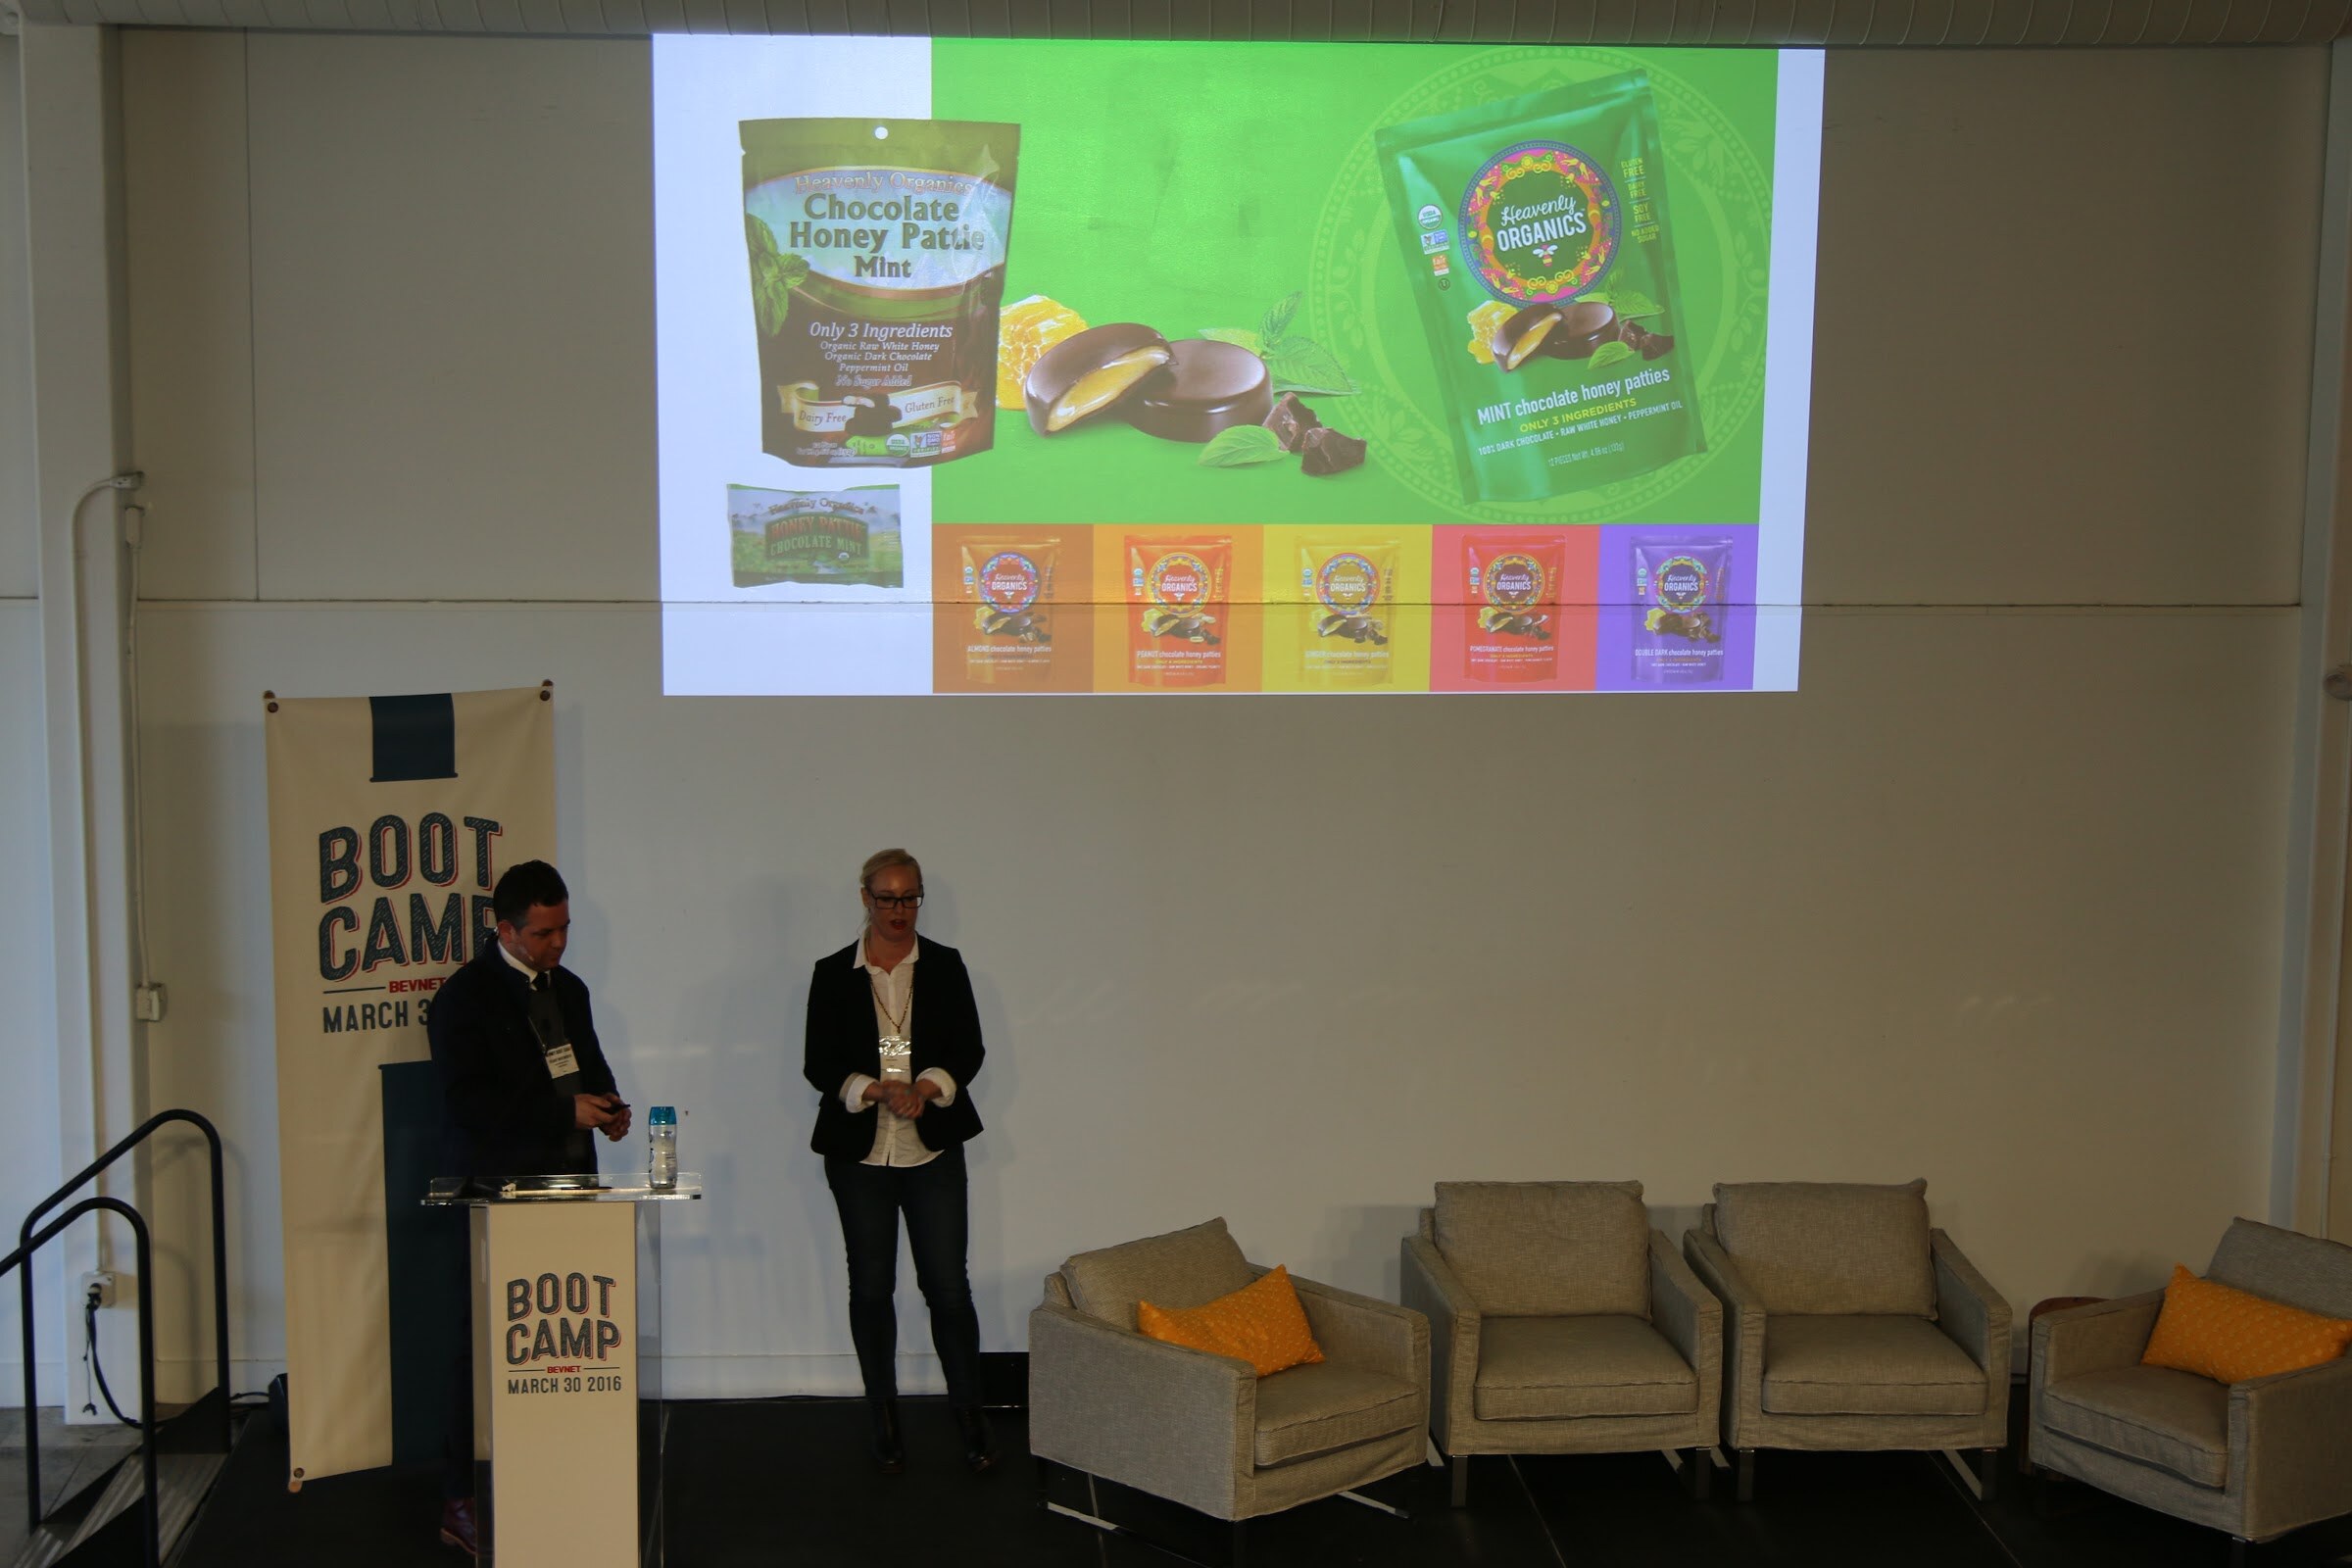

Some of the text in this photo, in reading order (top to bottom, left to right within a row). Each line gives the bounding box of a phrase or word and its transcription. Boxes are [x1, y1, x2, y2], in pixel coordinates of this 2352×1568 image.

[1623, 165, 1644, 177] FREE
[795, 172, 973, 196] Heavenly Organics
[804, 193, 959, 221] Chocolate
[1500, 195, 1576, 226] Heavenly
[1633, 202, 1648, 215] SOY
[790, 221, 984, 254] Honey Pattie
[1496, 213, 1587, 252] ORGANICS
[855, 256, 911, 278] Mint
[809, 321, 953, 341] Only 3 Ingredients
[820, 341, 857, 352] Organic
[911, 342, 940, 353] Honey
[824, 352, 861, 363] Organic
[889, 352, 932, 361] Chocolate
[839, 364, 891, 373] Peppermint
[906, 396, 955, 414] Gluten Free
[1477, 368, 1670, 425] MINT chocolate honey patties
[799, 411, 847, 426] Dairy Free
[1520, 398, 1637, 432] ONLY 3 INGREDIENTS
[1478, 401, 1683, 455] 100% DARK CHOCOLATE RAW WHITE HONEY PEPPERMINT OIL
[770, 535, 862, 557] CHOCOLATE MINT
[992, 581, 1027, 590] ORGANICS
[1161, 583, 1198, 592] ORGANICS
[1330, 583, 1366, 592] ORGANICS
[1496, 581, 1531, 590] ORGANICS
[1664, 582, 1698, 591] ORGANICS
[318, 812, 503, 904] BOOT
[389, 977, 446, 993] BEVNET
[323, 1001, 409, 1033] MARCH
[507, 1272, 615, 1322] BOOT
[507, 1317, 621, 1365] CAMP
[547, 1365, 581, 1374] BEVNET
[508, 1376, 621, 1394] MARCH 30 2016
